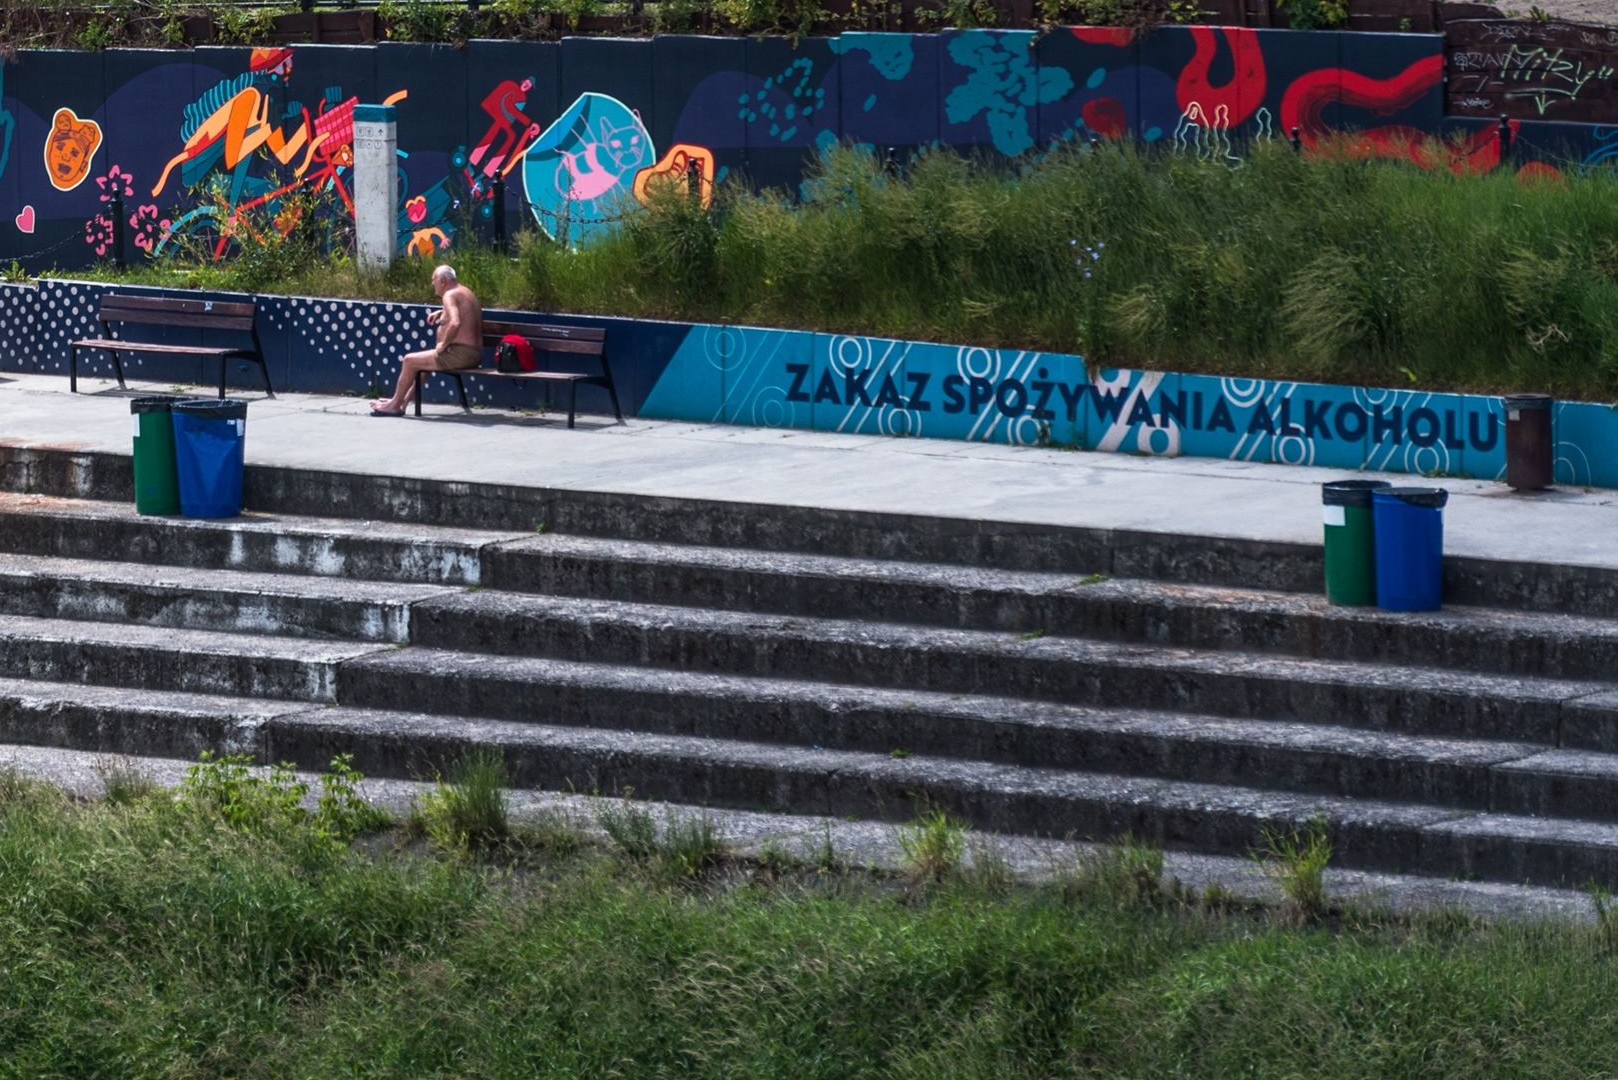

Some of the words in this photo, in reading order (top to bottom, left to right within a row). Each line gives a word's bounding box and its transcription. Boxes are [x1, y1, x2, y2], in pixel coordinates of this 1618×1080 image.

[785, 363, 931, 412] ZAKAZ
[942, 367, 1238, 434] SPOŻYWANIA
[1246, 397, 1499, 453] ALKOHOLU
